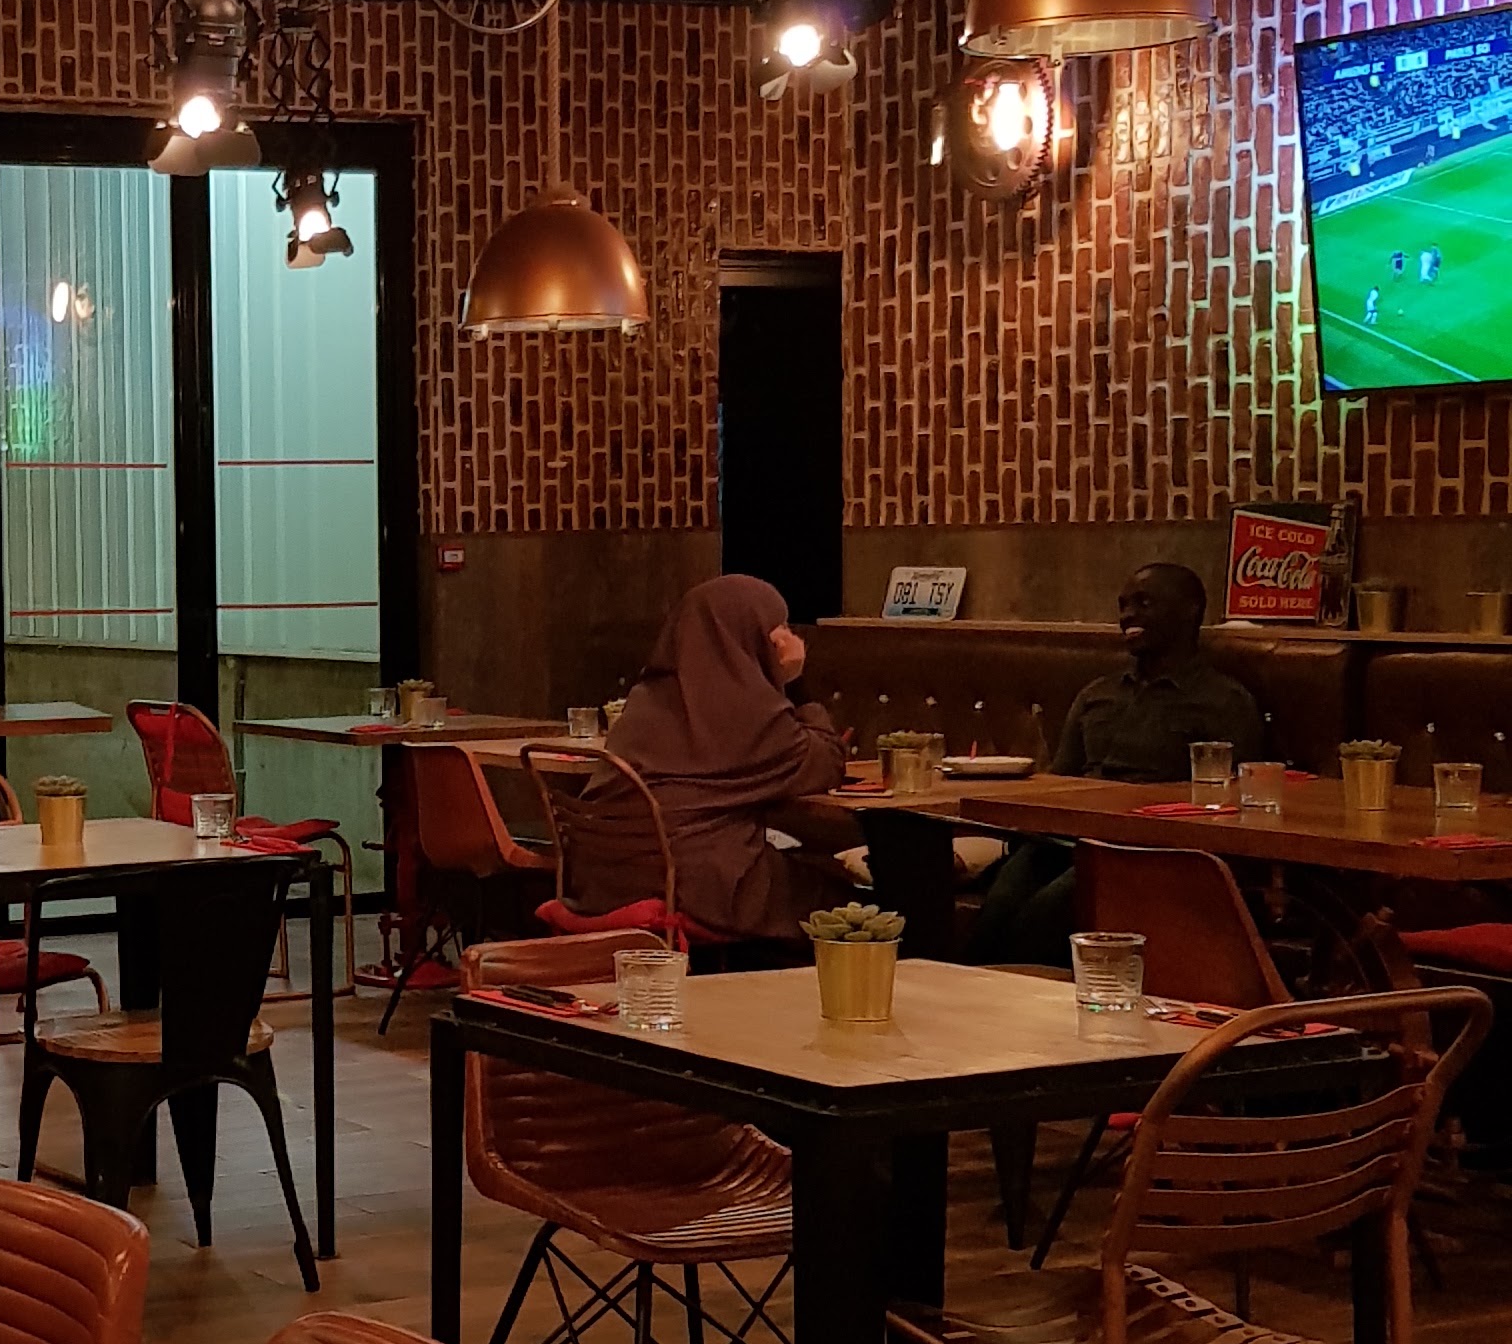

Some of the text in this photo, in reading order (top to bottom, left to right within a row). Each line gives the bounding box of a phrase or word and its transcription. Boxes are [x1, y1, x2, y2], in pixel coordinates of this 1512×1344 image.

[1249, 524, 1315, 545] ICE COLD
[1235, 546, 1320, 590] Coca-Cola
[930, 582, 955, 605] TSY
[1239, 595, 1314, 609] SOLD HERE
